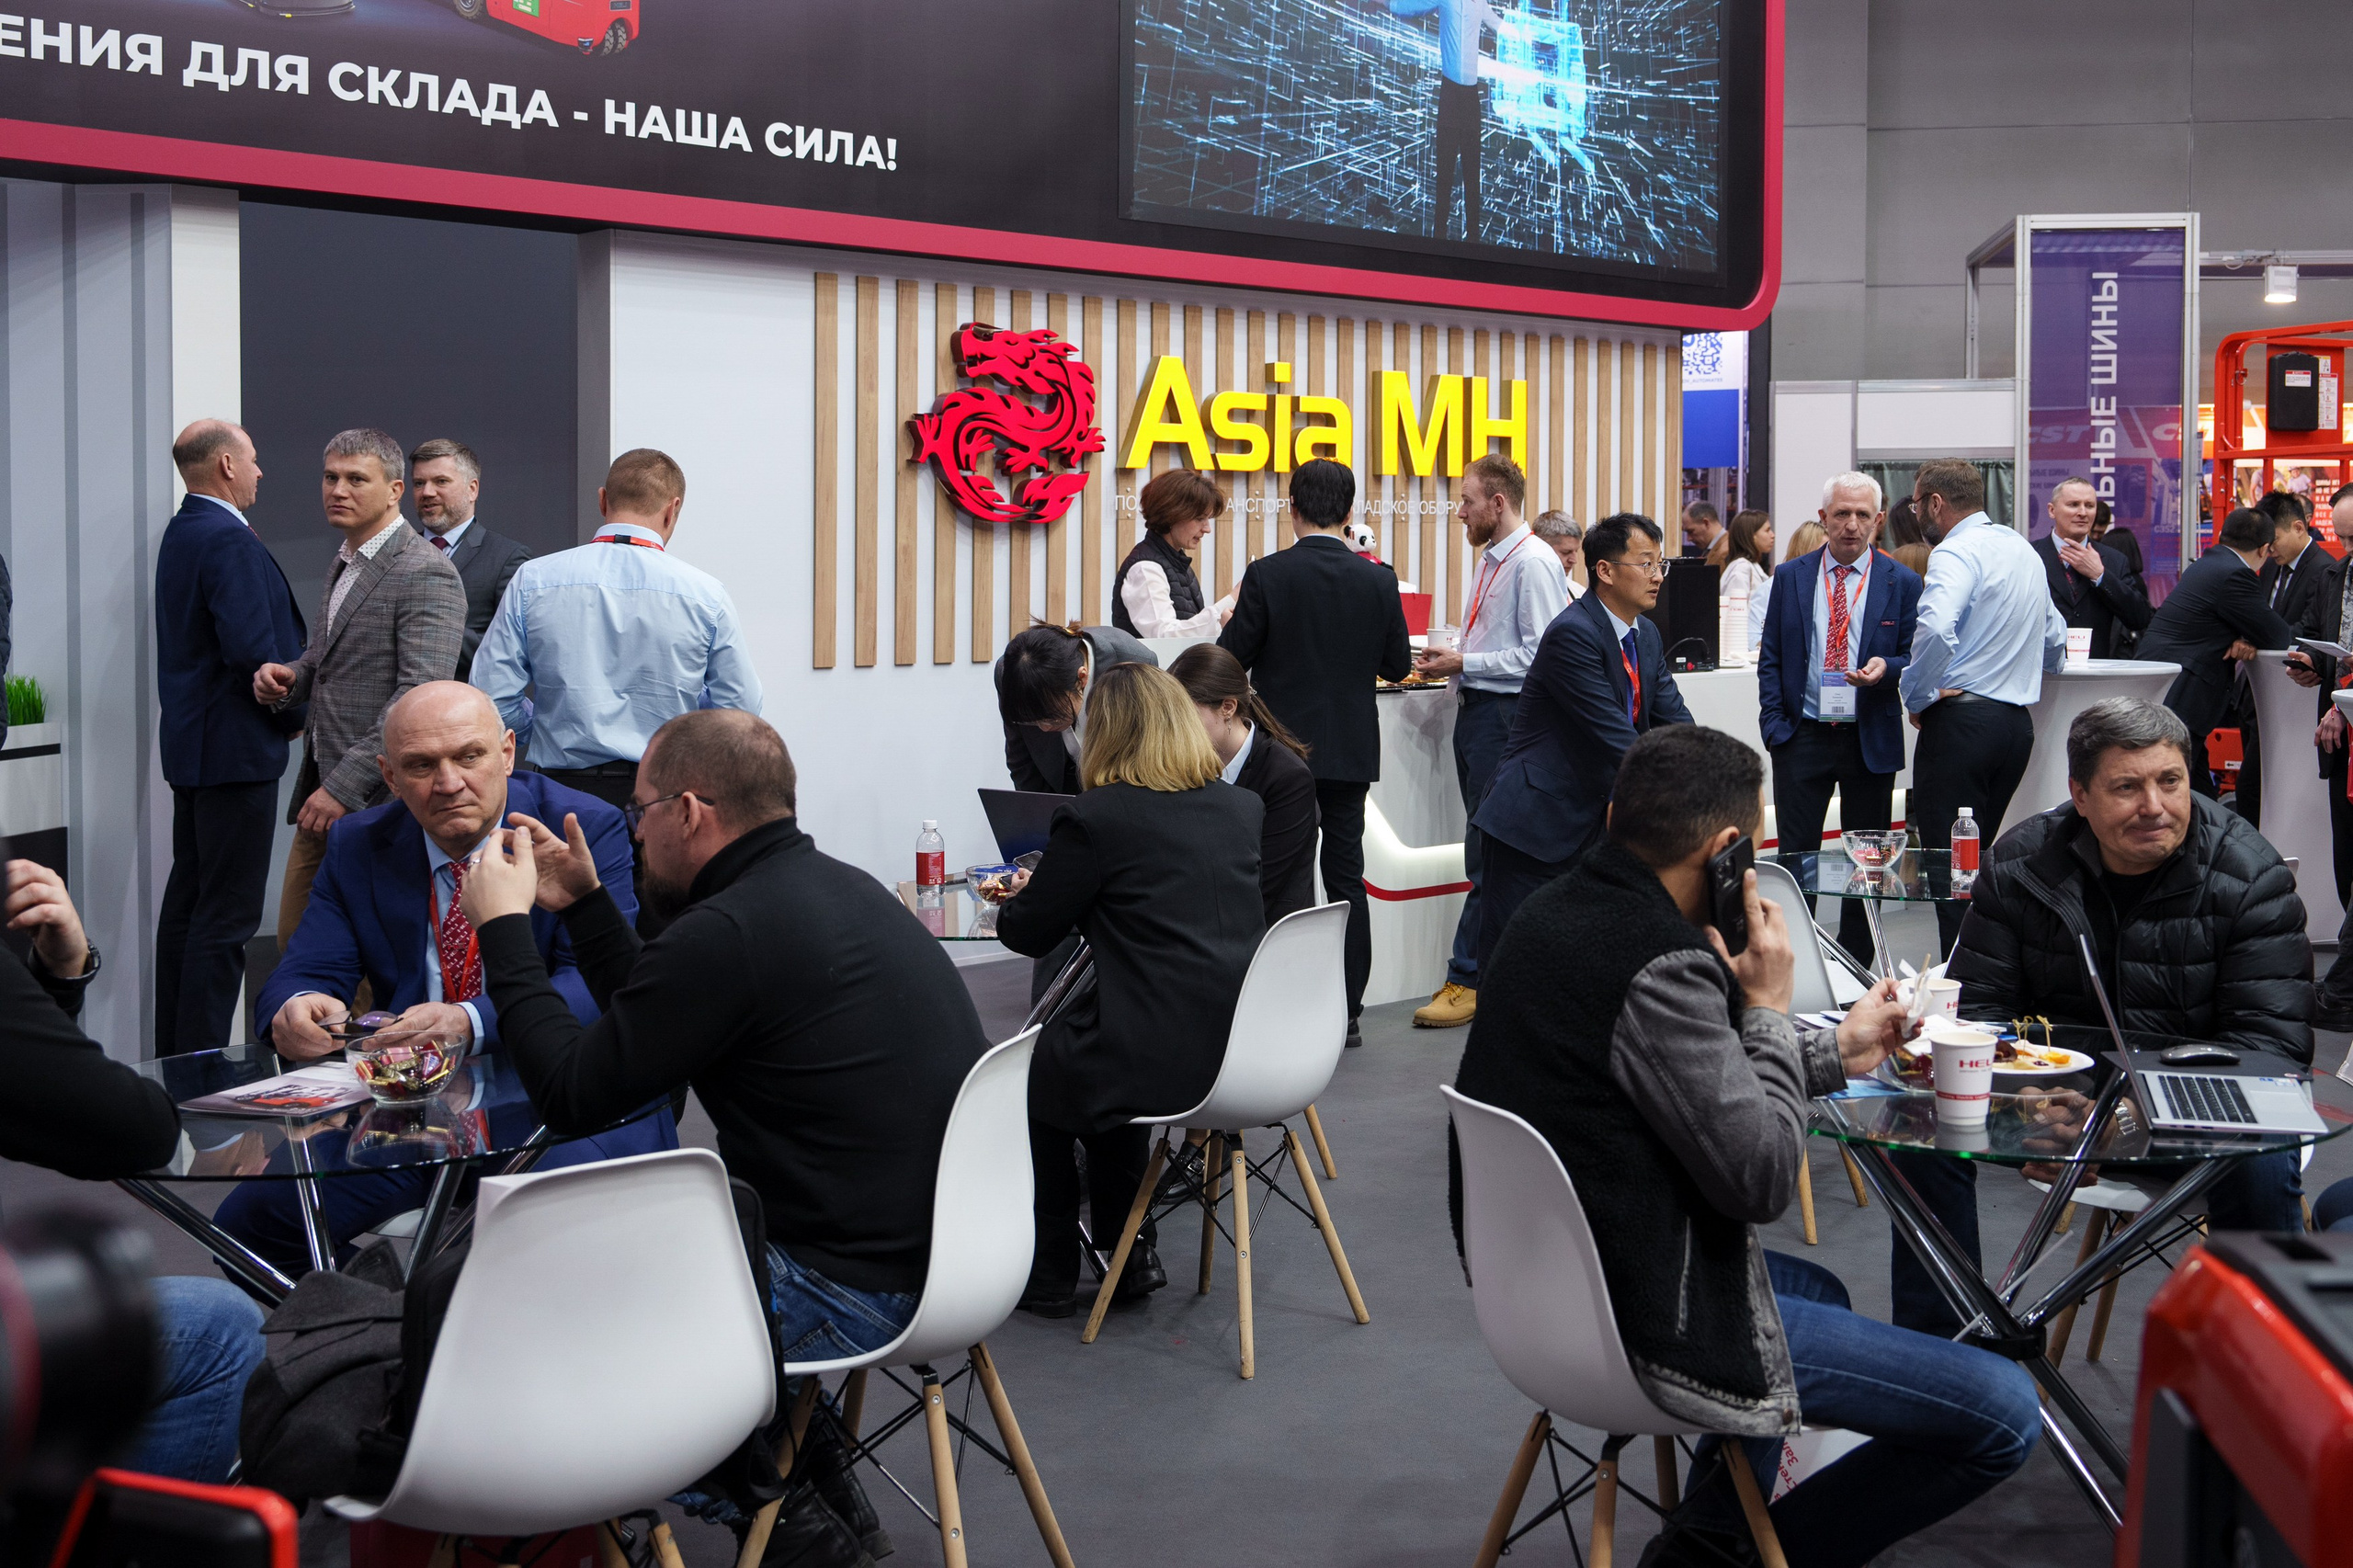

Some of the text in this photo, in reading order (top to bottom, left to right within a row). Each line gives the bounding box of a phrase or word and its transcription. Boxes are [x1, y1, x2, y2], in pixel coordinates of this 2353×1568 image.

[0, 13, 898, 171] ЕНИЯ ДЛЯ СКЛАДА - НАША СИЛА!
[1123, 356, 1528, 480] Asia MH
[2090, 271, 2119, 533] ЬНЫЕ ШИНЫ
[1115, 494, 1464, 517] ПО АНСПОРТ ЛАДСКОЕ ОБОРУ
[1959, 1059, 1993, 1068] HEL
[1777, 1458, 1798, 1492] Стен
